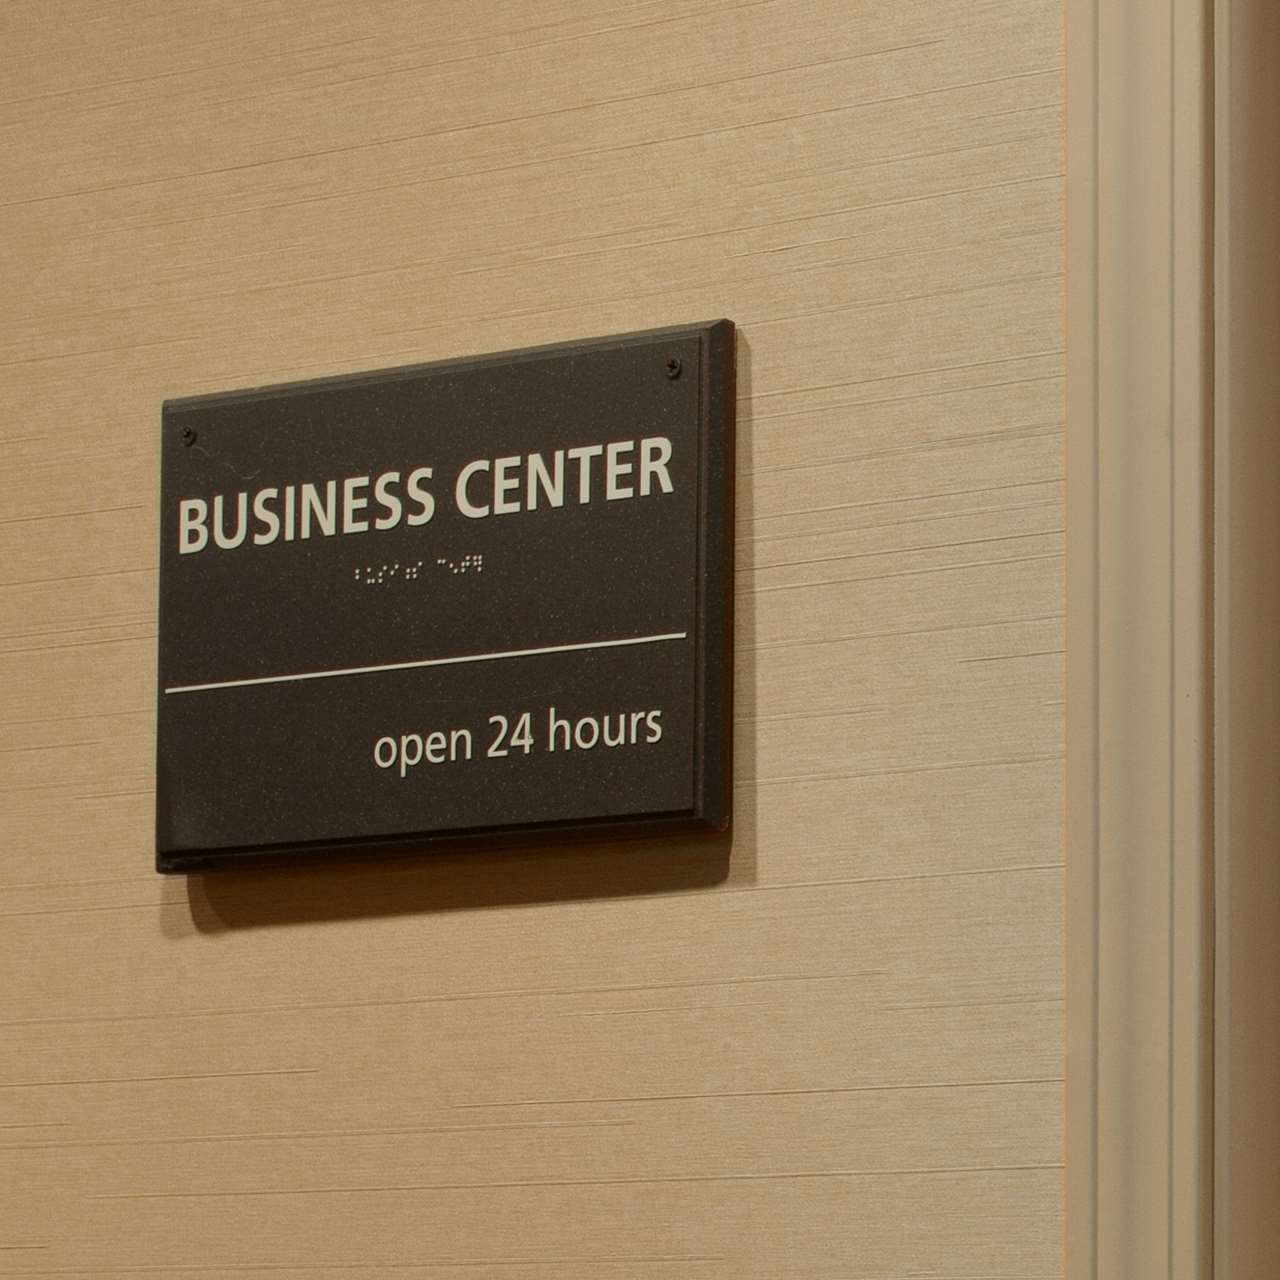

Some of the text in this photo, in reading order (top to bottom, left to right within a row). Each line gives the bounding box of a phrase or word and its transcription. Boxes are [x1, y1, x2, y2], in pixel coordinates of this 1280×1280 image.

[179, 436, 674, 554] BUSINESS CENTER
[373, 706, 662, 778] open 24 hours
